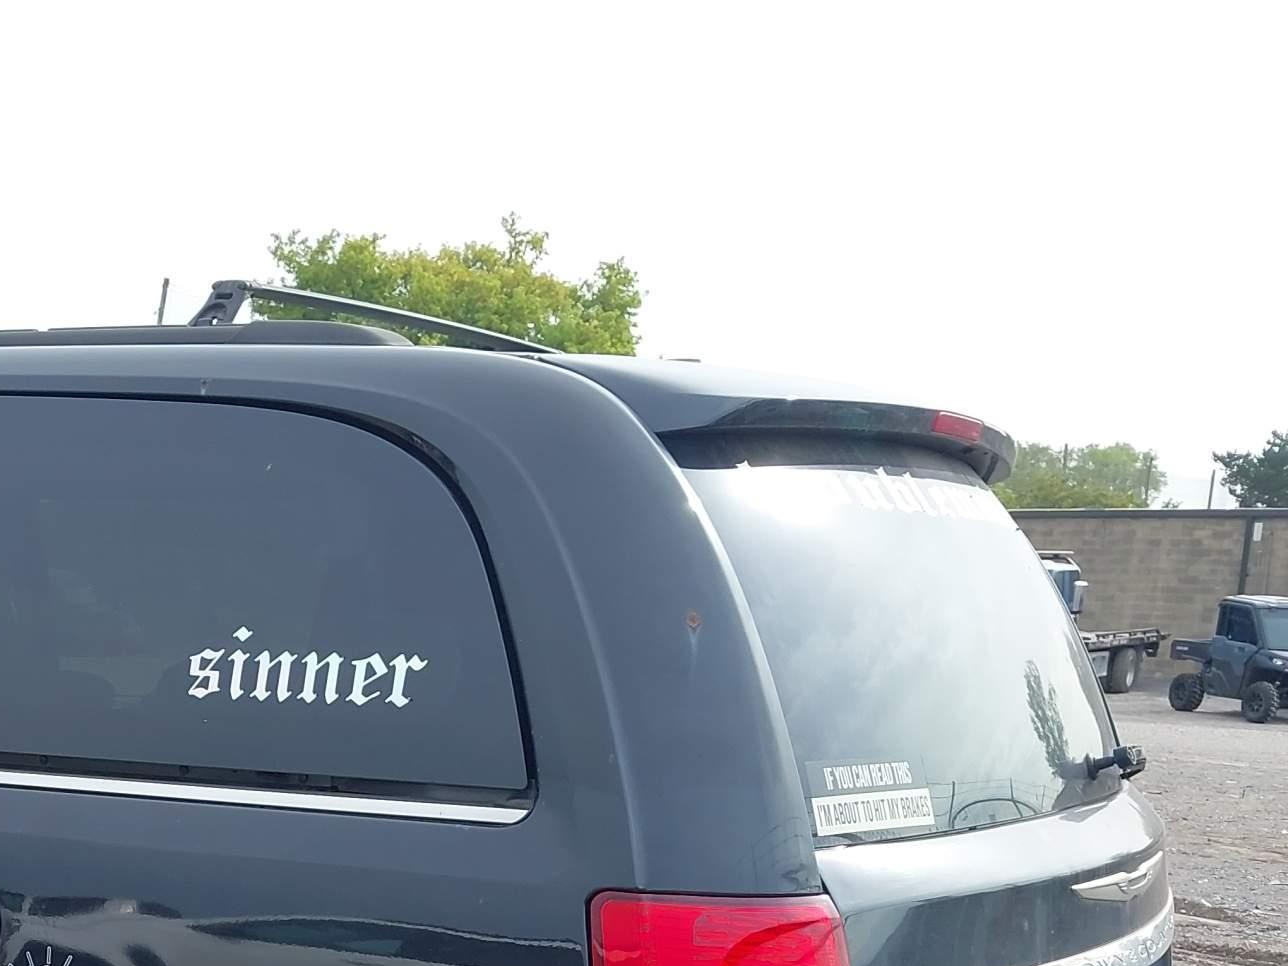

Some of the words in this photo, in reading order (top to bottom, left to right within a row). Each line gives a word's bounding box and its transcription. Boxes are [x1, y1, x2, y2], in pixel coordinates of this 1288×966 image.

[187, 625, 429, 709] sinner
[823, 767, 834, 790] IF
[832, 765, 854, 789] YOU
[852, 763, 872, 788] CAN
[869, 762, 894, 787] READ
[891, 761, 913, 785] THIS
[816, 804, 834, 827] I'M
[833, 801, 862, 826] ABOUT
[860, 800, 874, 823] TO
[872, 798, 888, 822] HIT
[886, 798, 901, 820] MY
[900, 795, 931, 820] BRAKES
